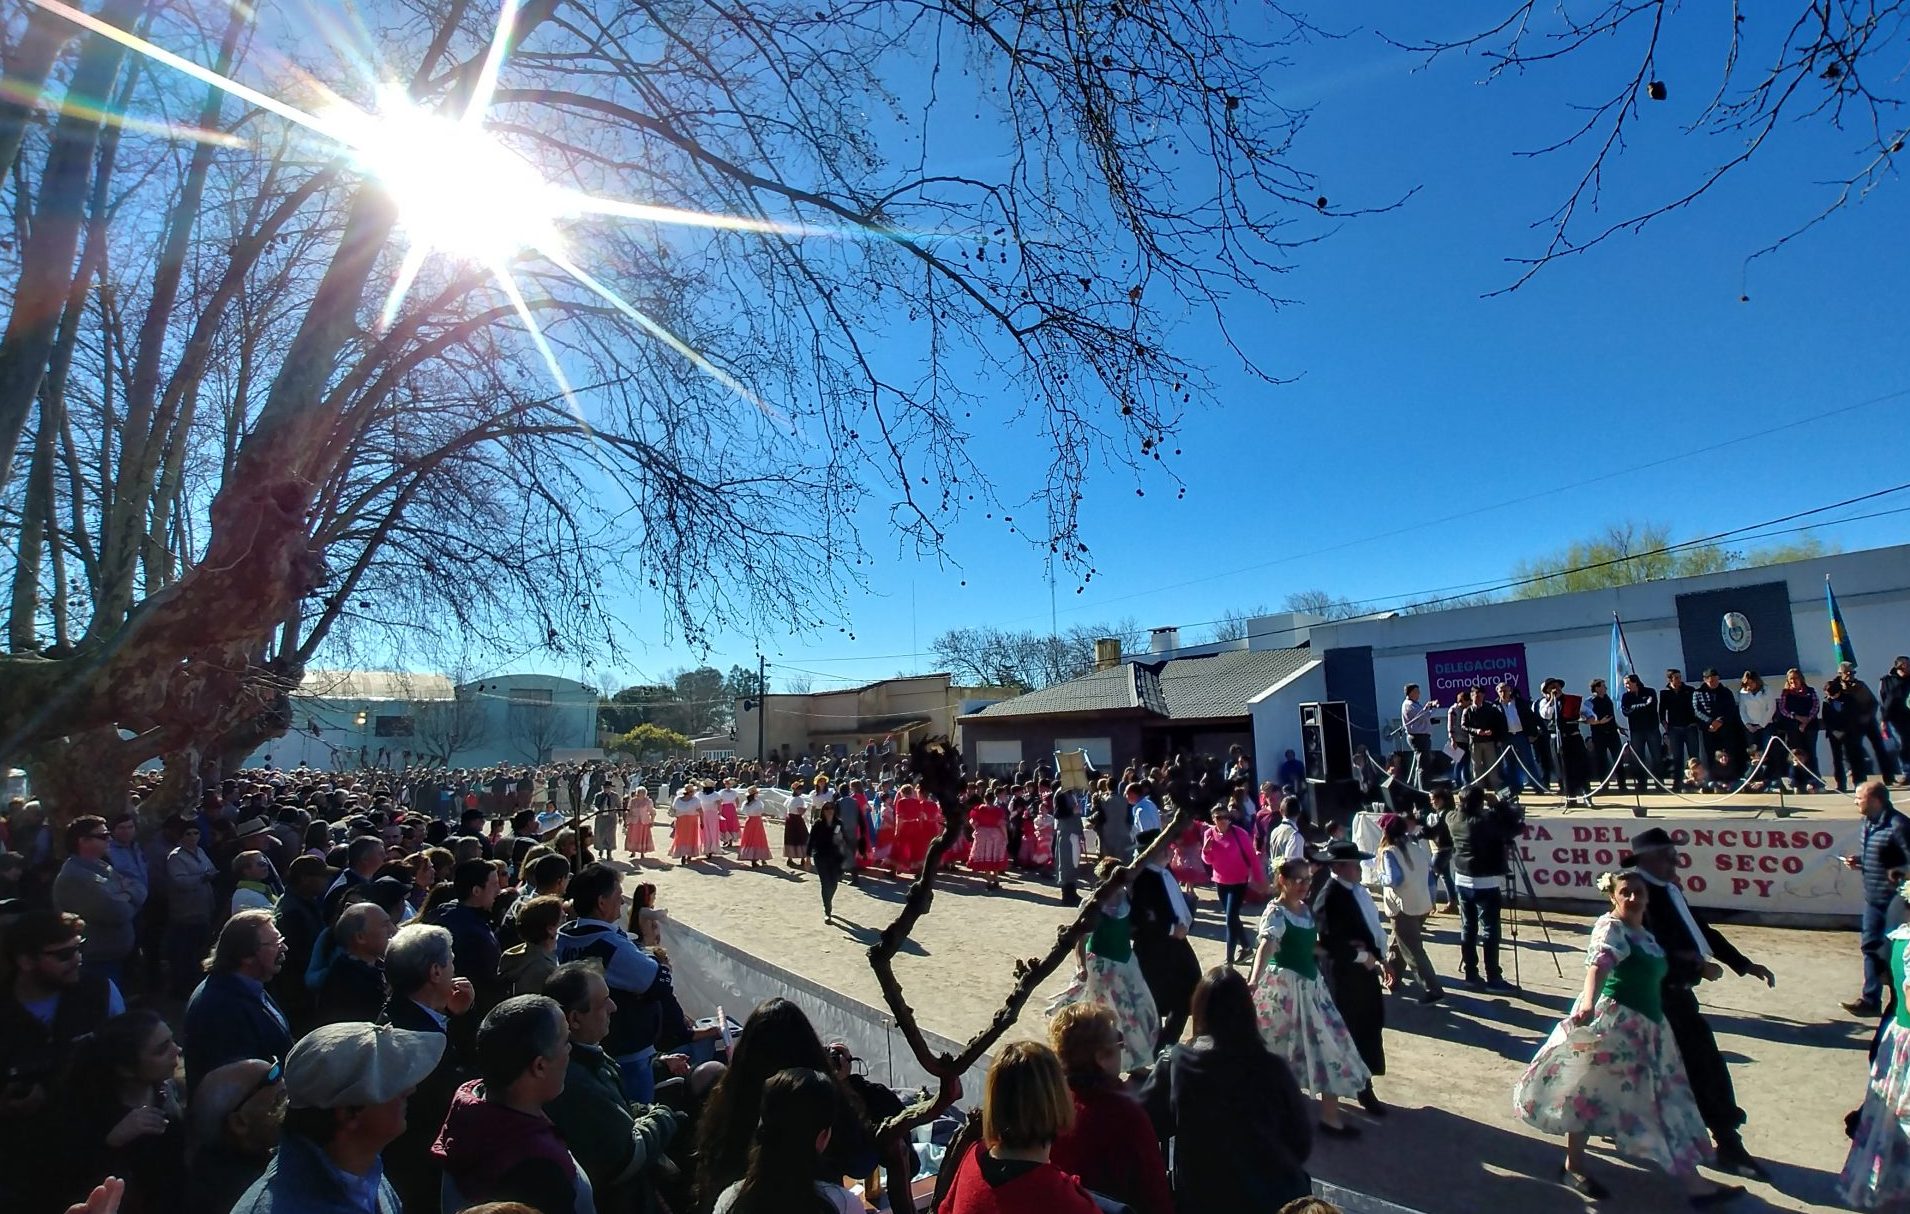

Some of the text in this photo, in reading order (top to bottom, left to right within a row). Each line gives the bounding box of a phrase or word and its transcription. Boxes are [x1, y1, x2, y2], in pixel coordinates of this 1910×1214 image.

[1435, 657, 1517, 674] DELEGACION
[1437, 672, 1519, 689] Comodoro Py
[1522, 825, 1833, 849] TA DEL ONCURSO
[1715, 854, 1803, 874] SECO
[1731, 878, 1774, 897] PY
